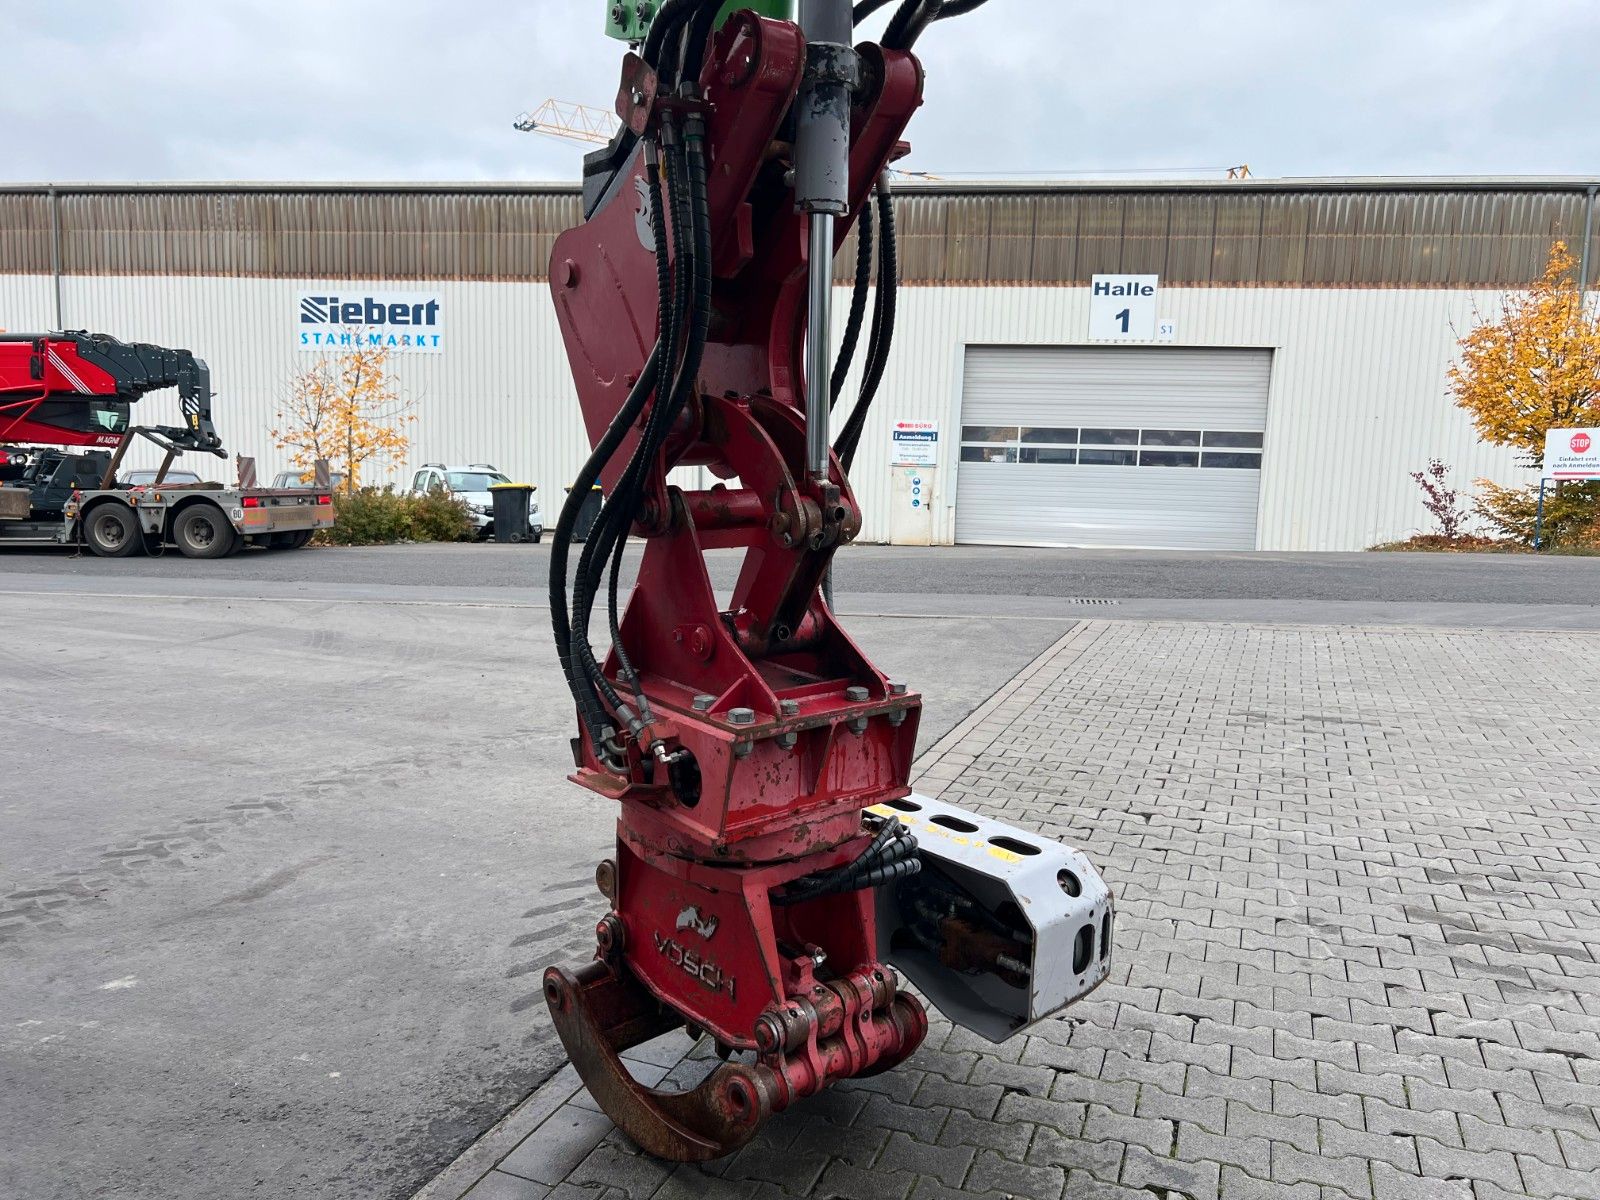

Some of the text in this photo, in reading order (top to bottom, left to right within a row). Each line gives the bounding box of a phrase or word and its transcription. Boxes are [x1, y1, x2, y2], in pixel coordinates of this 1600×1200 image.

[1094, 282, 1154, 297] Halle
[300, 296, 440, 325] Siebert
[1115, 309, 1130, 333] 1
[300, 332, 440, 347] STAHLMARKT
[96, 435, 120, 445] MAGNI
[1571, 438, 1590, 448] STOP
[654, 930, 736, 1001] VOSCH
